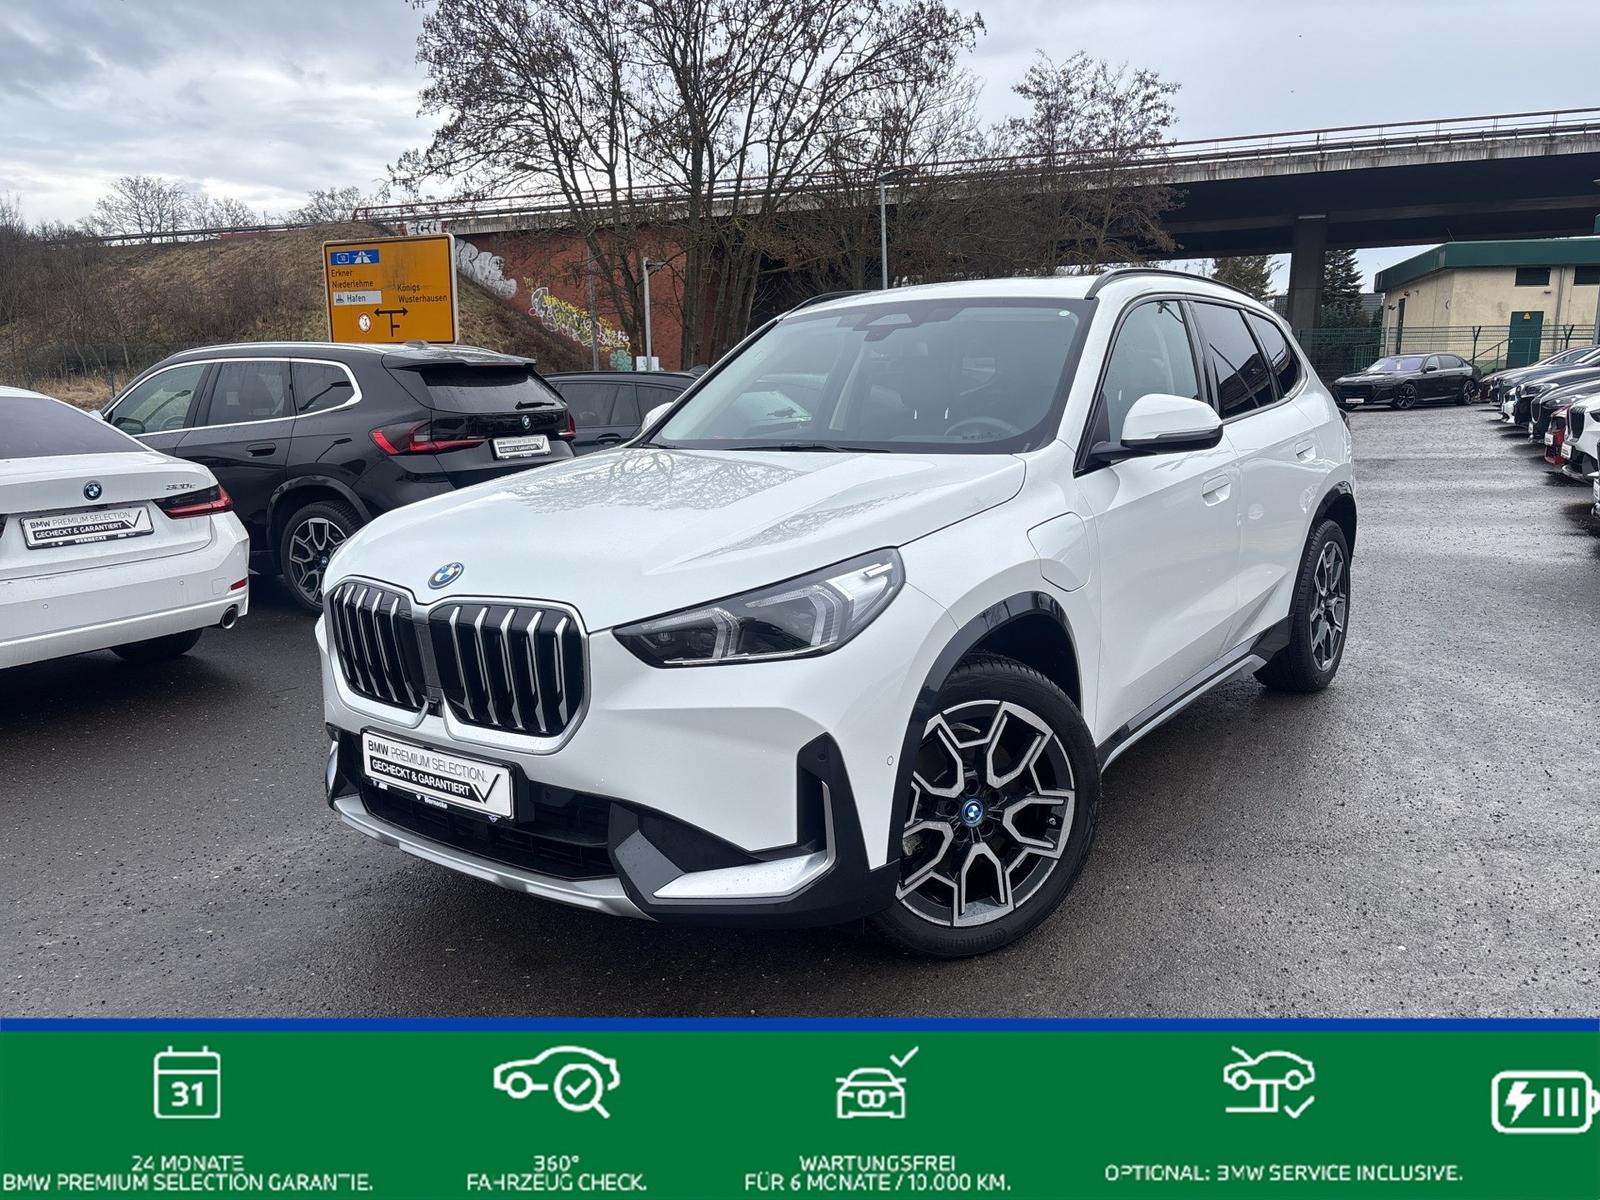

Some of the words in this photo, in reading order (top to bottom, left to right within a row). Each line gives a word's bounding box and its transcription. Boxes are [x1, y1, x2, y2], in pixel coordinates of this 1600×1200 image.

[398, 284, 420, 293] Königs
[398, 295, 448, 303] Wusterhausen
[30, 520, 51, 529] BMW
[53, 516, 89, 526] PREMIUM
[35, 529, 72, 538] GECHECKT
[80, 522, 122, 533] GARANTIERT
[368, 740, 389, 756] BMW
[391, 746, 430, 768] PREMIUM
[372, 759, 411, 779] GECHECKT
[411, 771, 418, 782] &
[418, 773, 470, 796] GARANTIERT
